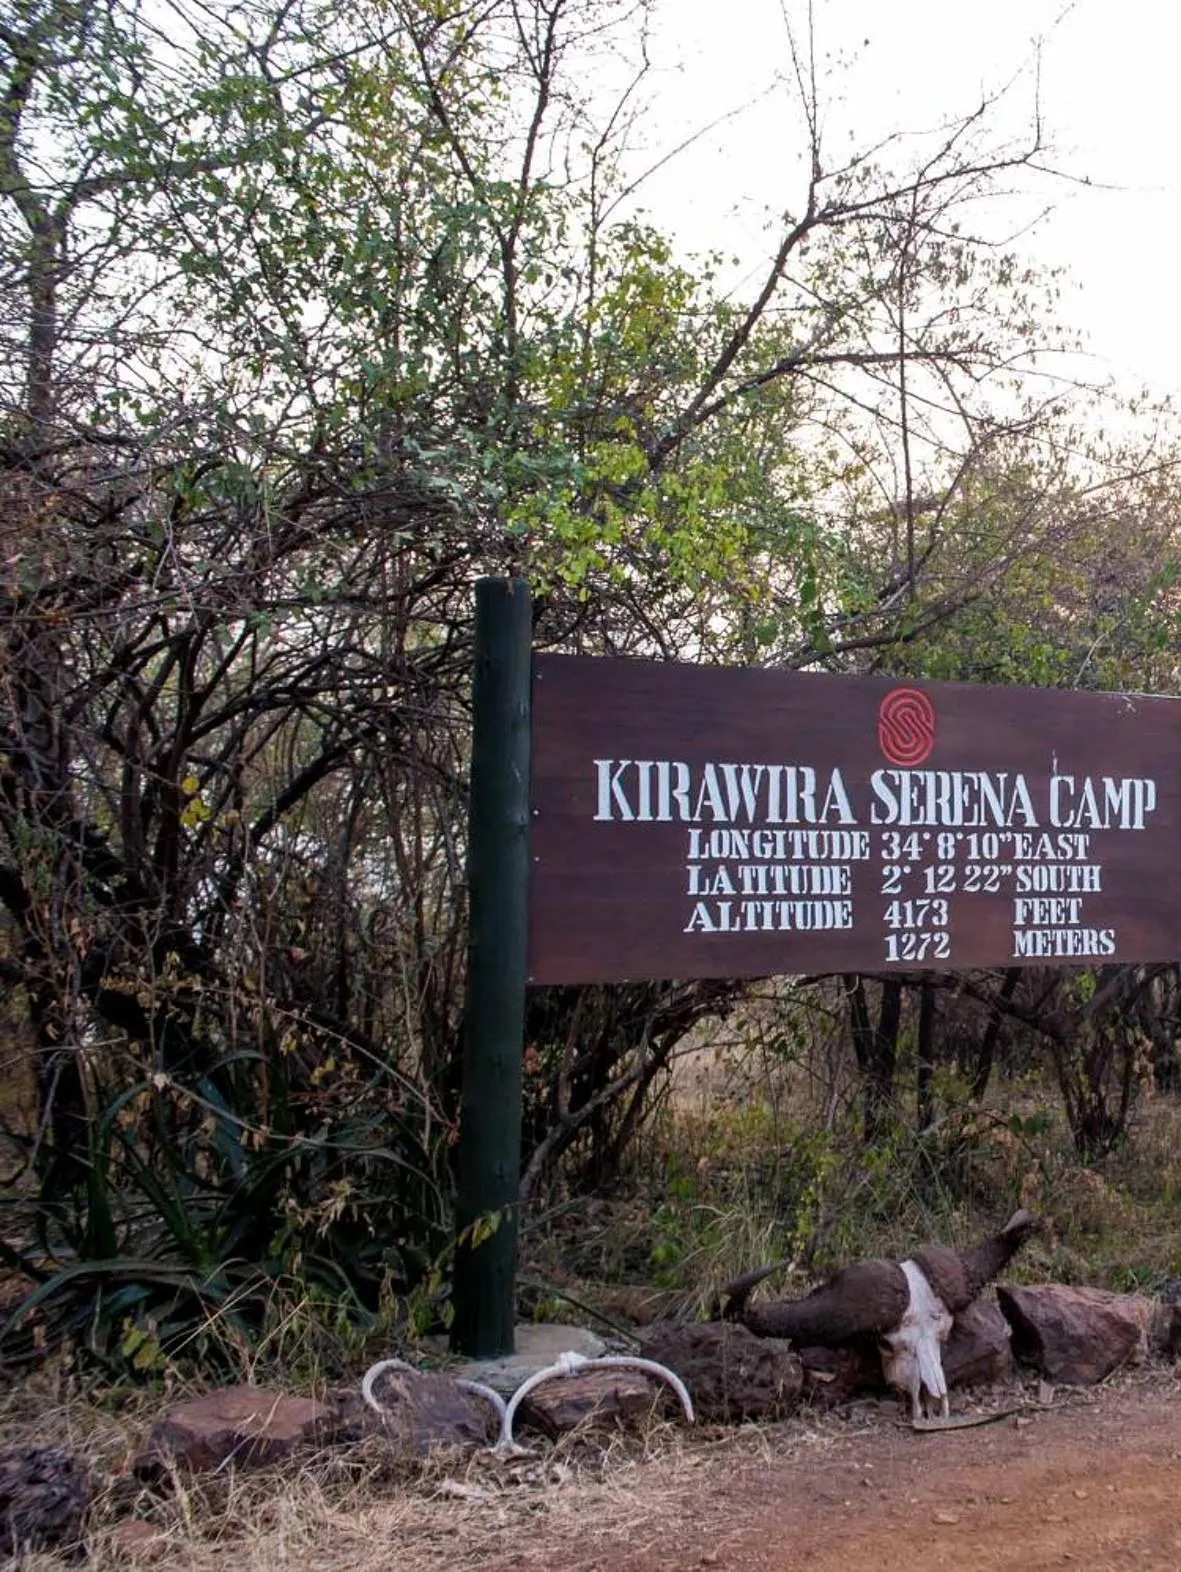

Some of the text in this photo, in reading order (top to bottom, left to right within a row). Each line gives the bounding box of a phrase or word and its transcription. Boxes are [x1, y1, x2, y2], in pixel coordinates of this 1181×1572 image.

[593, 759, 1157, 830] KIRAWIRA SERENA CAMP
[687, 828, 870, 860] LONGITUDE
[1012, 832, 1090, 860] EAST
[685, 864, 852, 896] LATITUDE
[923, 865, 957, 894] 12
[1015, 864, 1102, 893] SOUTH
[683, 897, 1083, 933] ALTITUDE 4173 FEET
[884, 928, 1116, 962] 1272 METERS
